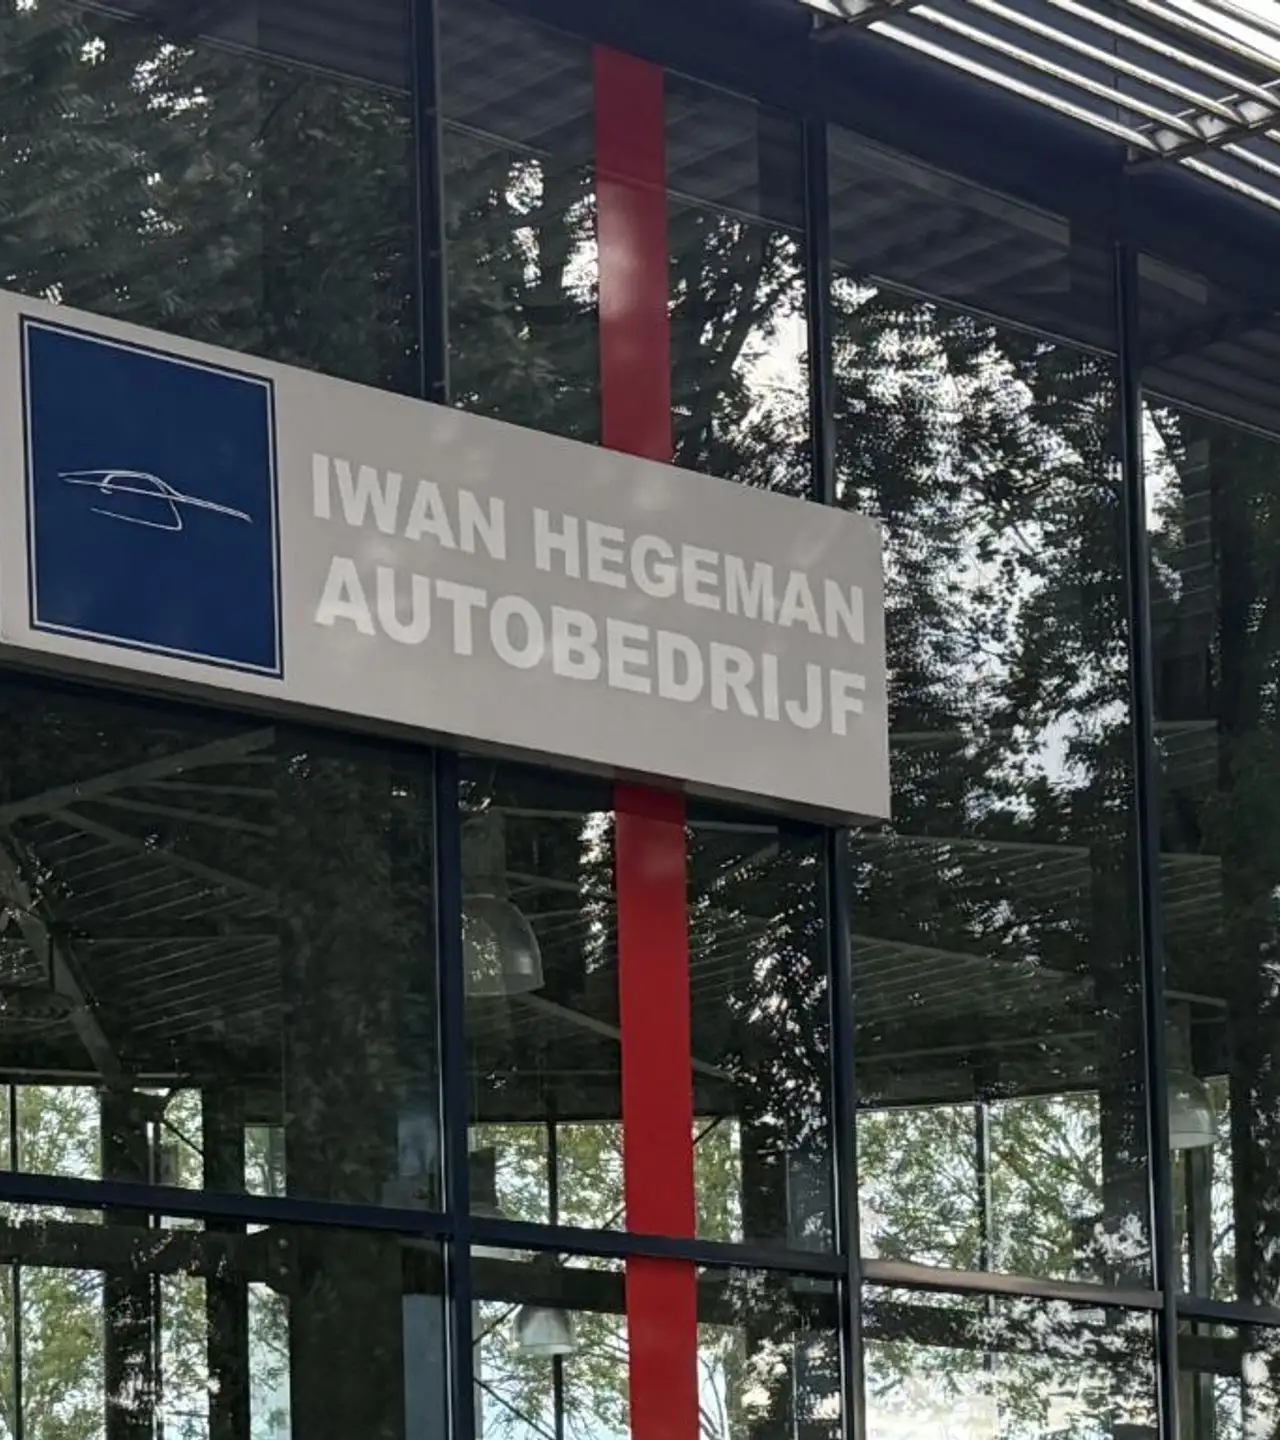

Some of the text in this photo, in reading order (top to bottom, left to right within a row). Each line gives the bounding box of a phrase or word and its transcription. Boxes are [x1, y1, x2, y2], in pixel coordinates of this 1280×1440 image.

[311, 452, 866, 645] IWAN HEGEMAN
[314, 555, 867, 736] AUTOBEDRIJF
